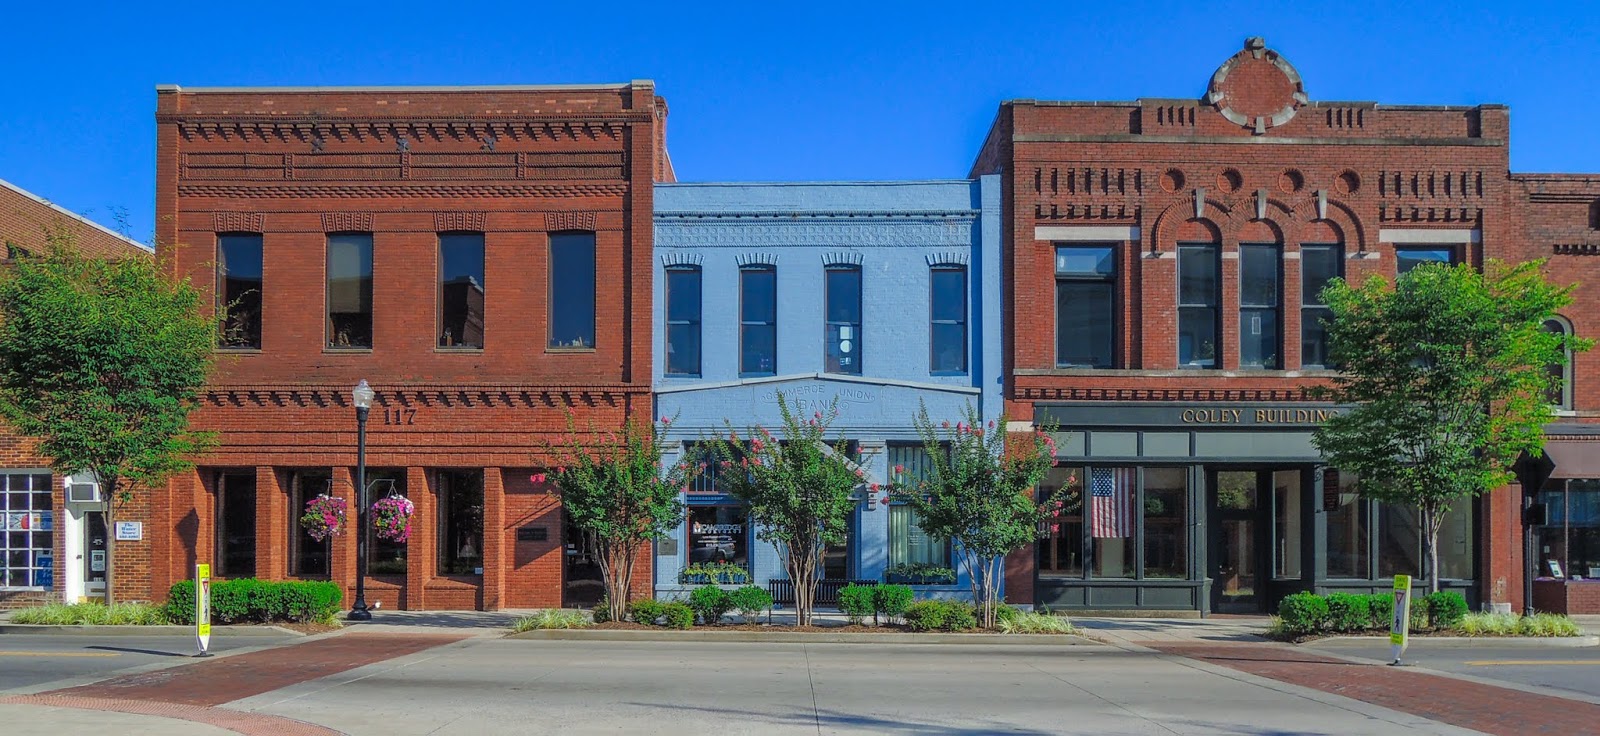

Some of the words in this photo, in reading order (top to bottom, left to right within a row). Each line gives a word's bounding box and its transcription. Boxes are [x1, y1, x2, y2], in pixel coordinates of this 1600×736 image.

[766, 384, 825, 400] COMMERCE
[839, 387, 871, 401] UNION
[384, 409, 417, 425] 117
[1182, 409, 1243, 423] COLEY
